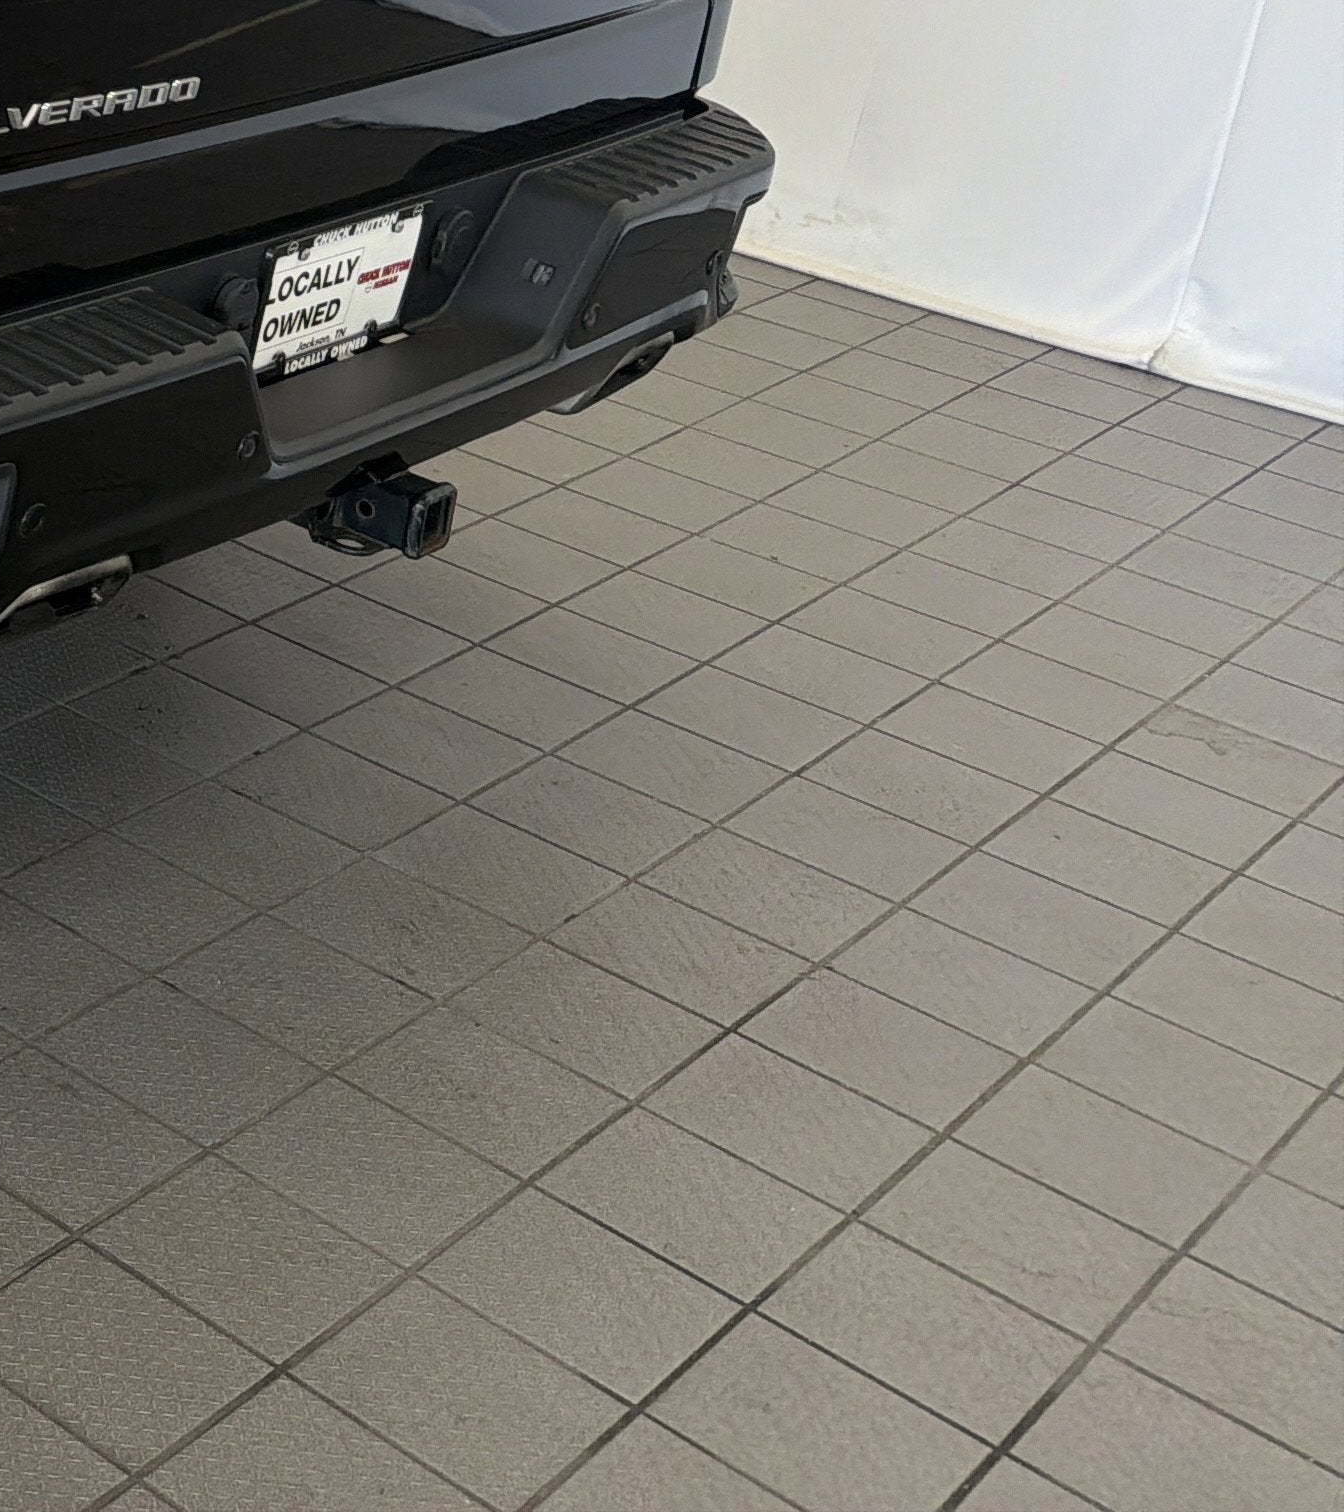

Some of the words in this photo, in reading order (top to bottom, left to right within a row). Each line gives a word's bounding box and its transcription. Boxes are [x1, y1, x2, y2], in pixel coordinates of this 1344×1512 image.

[313, 226, 352, 247] CHUCK
[354, 211, 399, 235] HUTTON
[265, 255, 360, 306] LOCALLY
[262, 298, 341, 343] OWNED
[334, 326, 347, 339] TN
[284, 349, 329, 375] LOCALLY
[330, 336, 368, 359] OWNED
